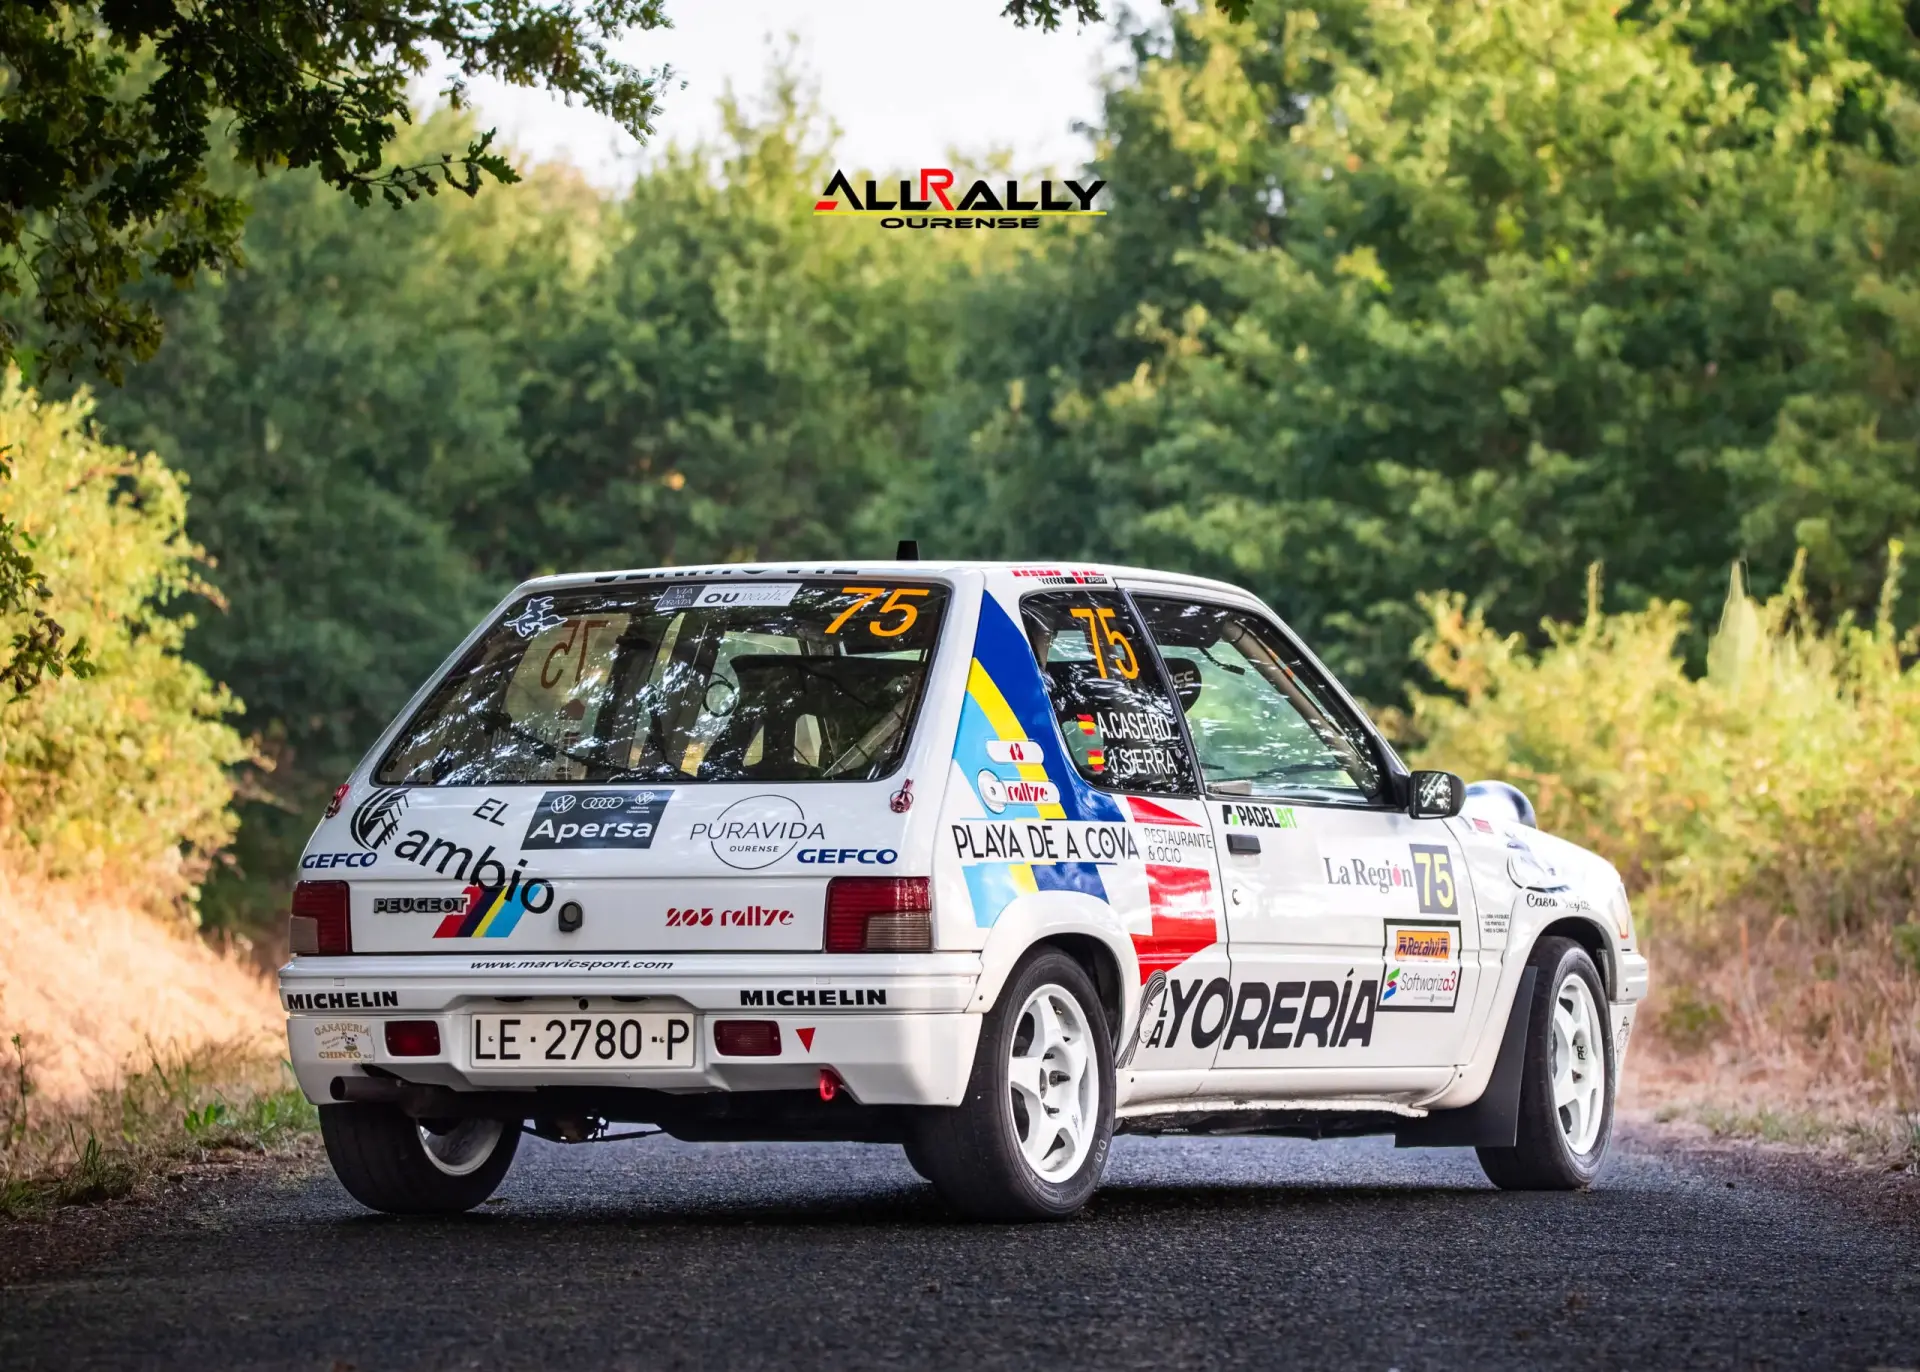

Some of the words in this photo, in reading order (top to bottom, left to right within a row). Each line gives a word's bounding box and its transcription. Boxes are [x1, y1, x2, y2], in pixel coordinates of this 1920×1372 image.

[703, 592, 740, 603] OU
[825, 587, 929, 637] 75
[1070, 608, 1139, 680] 75
[1098, 712, 1172, 740] A.CASEIRO
[1109, 749, 1179, 775] J.SIERRA
[473, 797, 509, 826] EL
[1238, 804, 1297, 828] PADELBIT
[529, 819, 653, 843] Apersa
[690, 822, 826, 841] PURAVIDA
[1144, 828, 1213, 849] RESTAURANTE
[951, 825, 1024, 859] PLAYA
[1027, 826, 1058, 859] DE
[1067, 827, 1081, 858] A
[1085, 828, 1140, 859] COVA
[303, 852, 377, 868] GEFCO
[797, 849, 898, 864] GEFCO
[1157, 848, 1182, 863] OCIO
[1323, 858, 1351, 885] La
[1353, 859, 1414, 893] Región
[1413, 852, 1455, 909] 75
[374, 898, 467, 914] PEUGEOT
[1526, 893, 1558, 908] Casa
[665, 907, 714, 927] 205
[720, 906, 795, 927] rallye
[1405, 937, 1441, 956] Recalvi
[470, 959, 675, 971] www.marvicsport.com
[286, 990, 399, 1010] MICHELIN
[739, 989, 887, 1006] MICHELIN
[475, 1019, 521, 1060] LE
[545, 1018, 643, 1060] 2780
[667, 1019, 690, 1060] P
